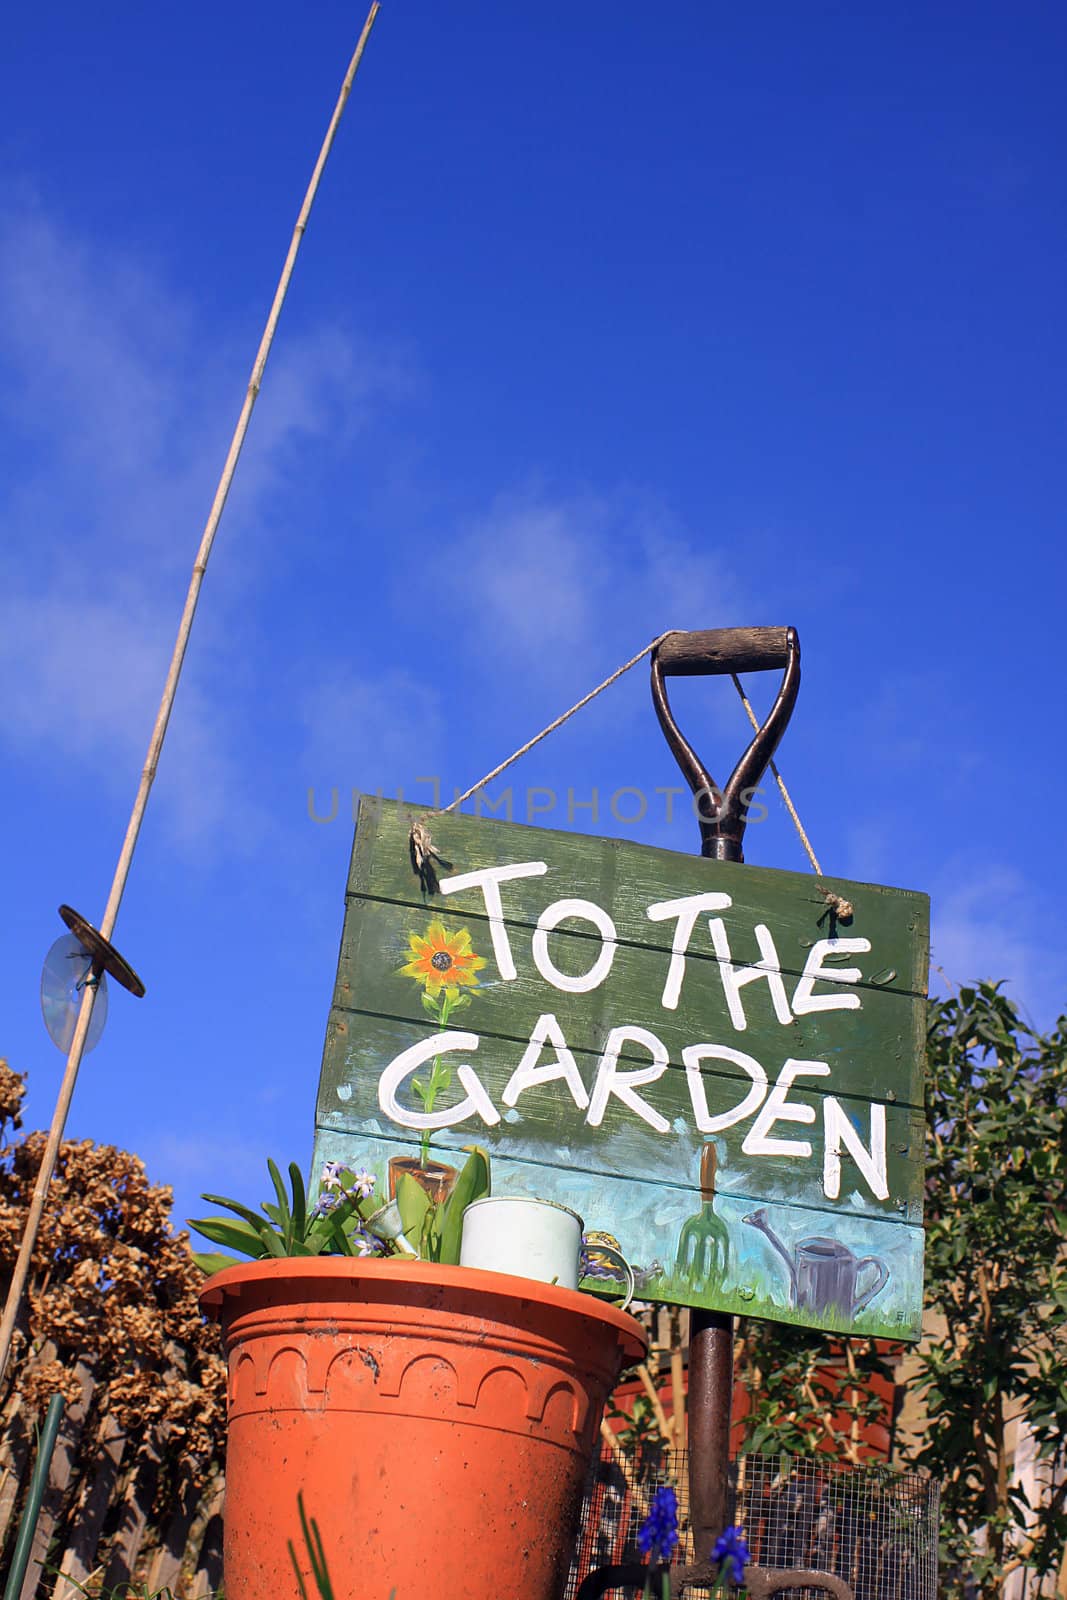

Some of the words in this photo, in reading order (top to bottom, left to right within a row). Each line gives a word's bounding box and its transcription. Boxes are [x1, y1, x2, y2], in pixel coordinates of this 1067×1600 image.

[439, 862, 619, 993] TO
[647, 892, 872, 1031] THE
[377, 1014, 890, 1201] GARDEN
